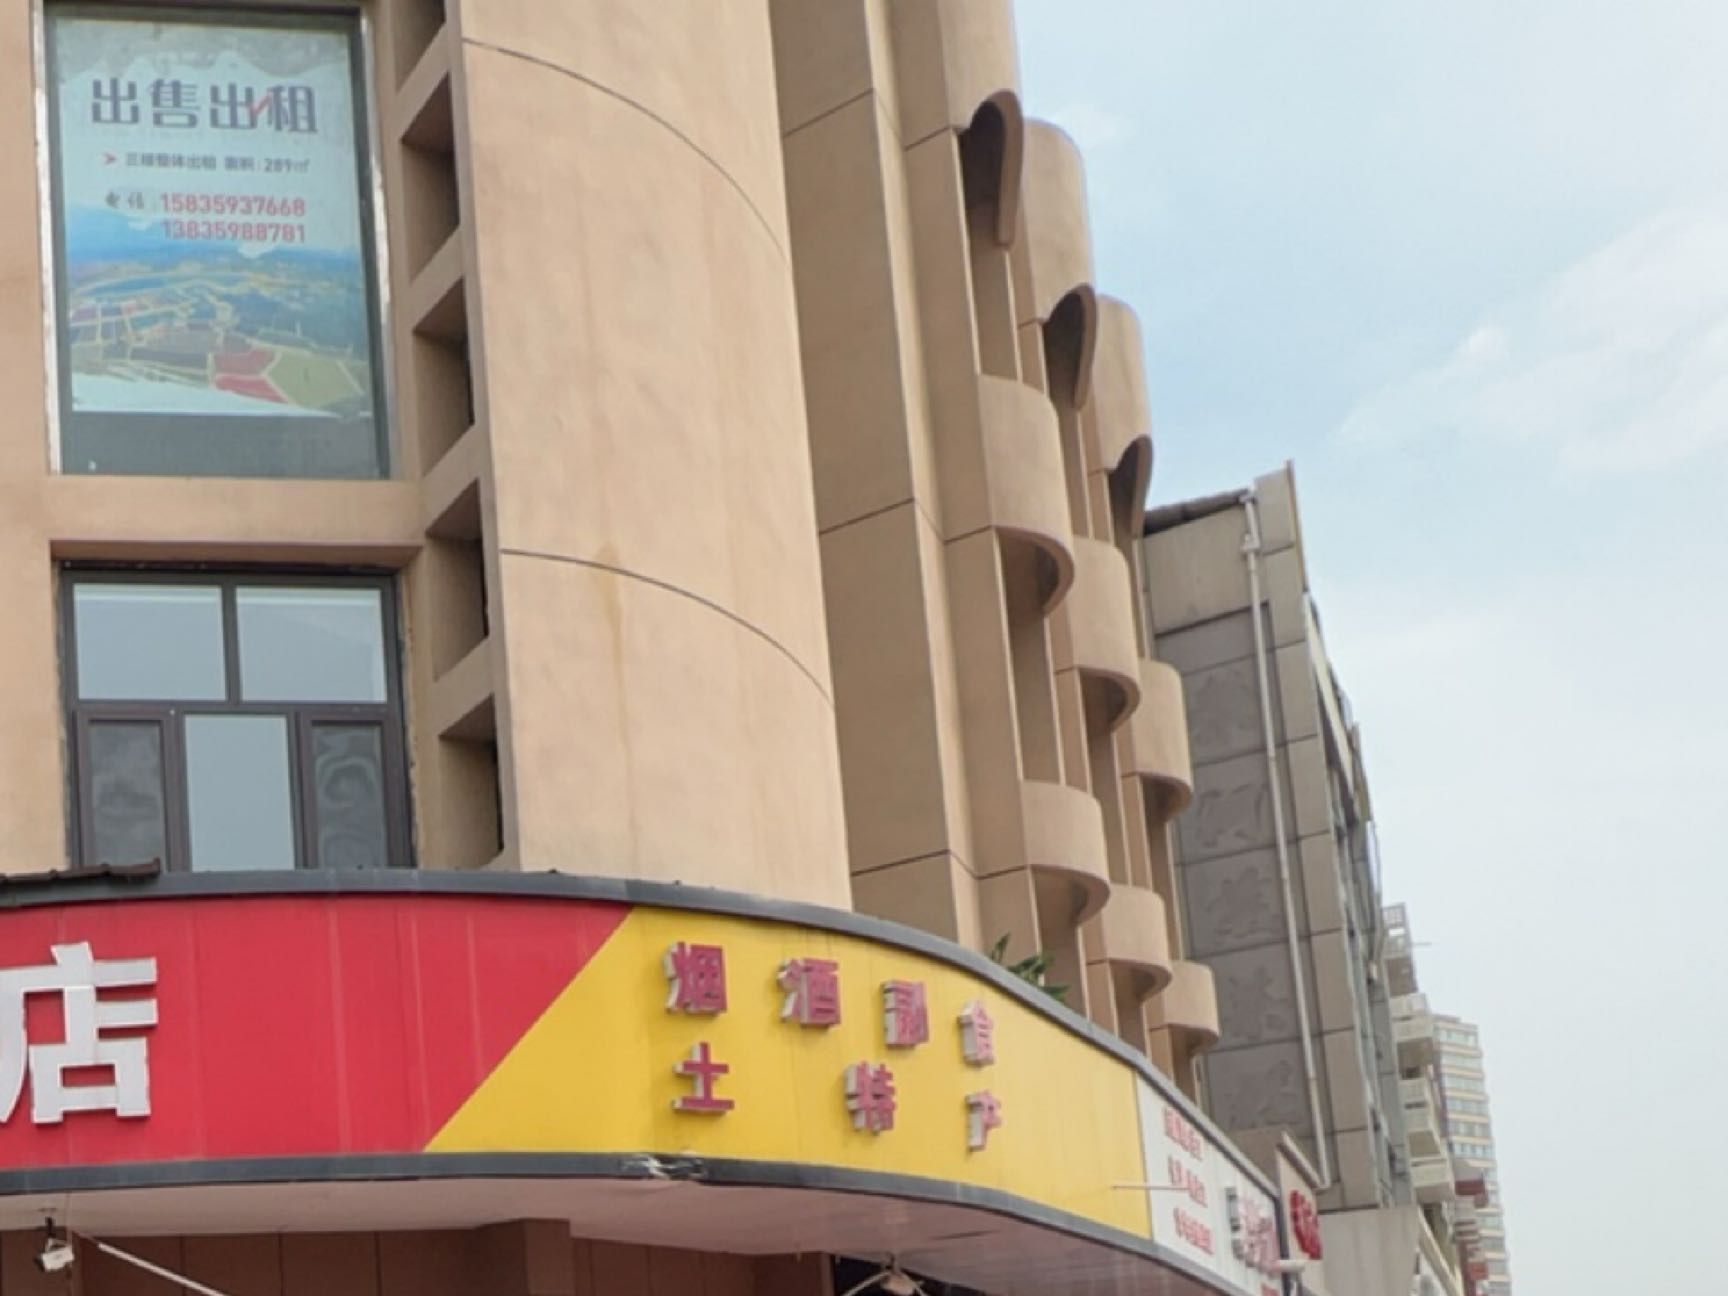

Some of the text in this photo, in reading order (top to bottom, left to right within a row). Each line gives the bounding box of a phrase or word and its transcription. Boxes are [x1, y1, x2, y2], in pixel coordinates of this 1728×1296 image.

[92, 77, 318, 134] 出售出租
[160, 192, 306, 217] 15835937668
[161, 218, 306, 243] 13835988781
[664, 941, 995, 1068] 烟酒副食
[673, 1041, 1003, 1152] 土特产
